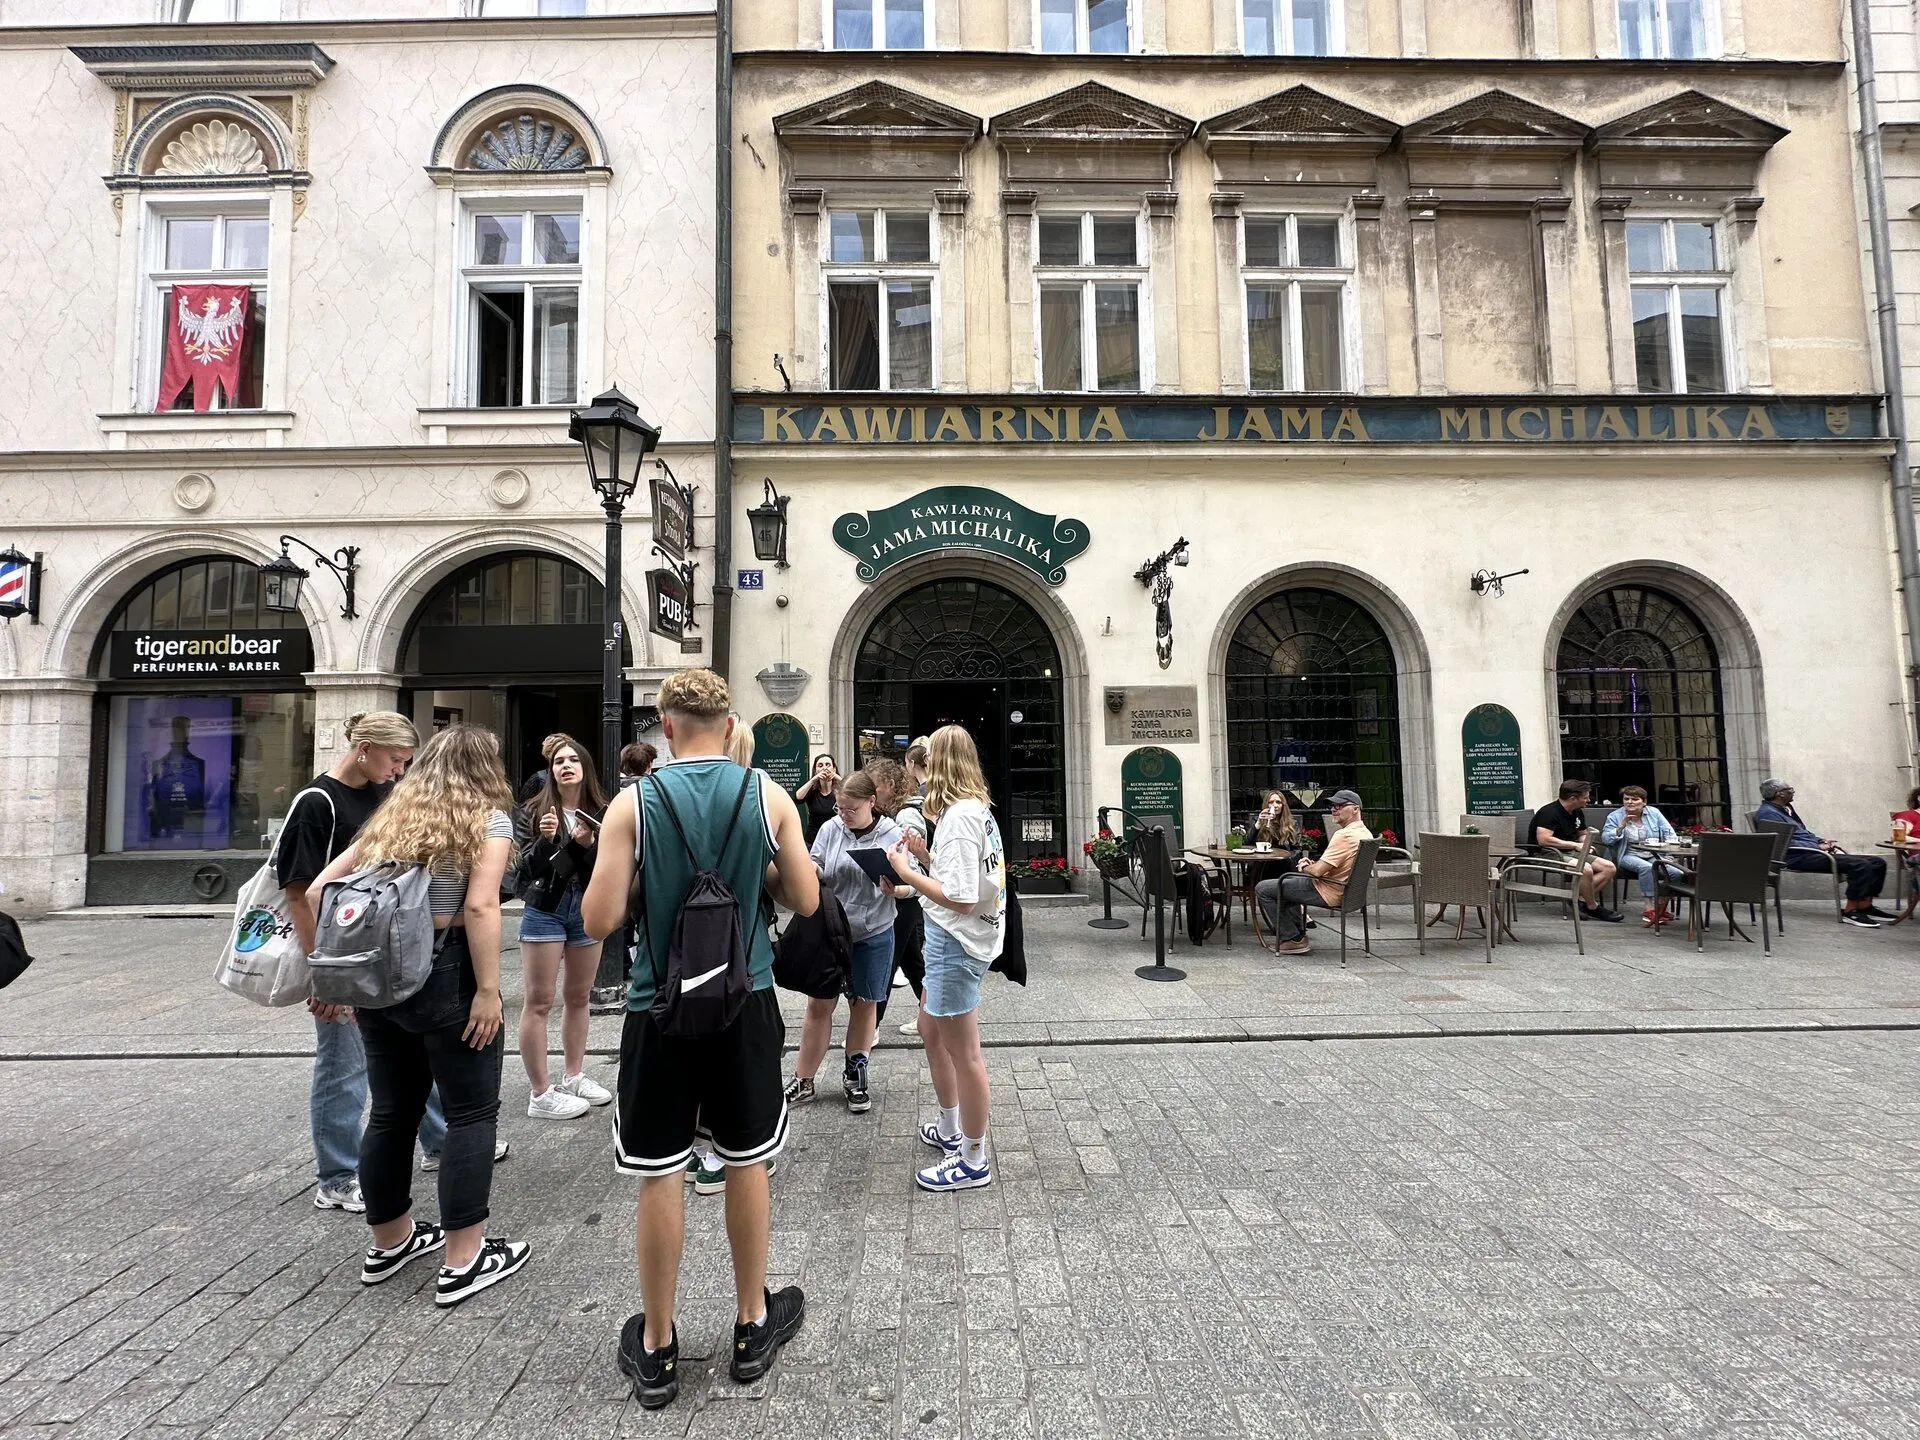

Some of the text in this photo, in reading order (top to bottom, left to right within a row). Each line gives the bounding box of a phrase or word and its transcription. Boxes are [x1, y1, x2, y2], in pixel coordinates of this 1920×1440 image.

[760, 406, 1782, 441] KAWIARNIA JAMA MICHALIKA
[911, 504, 1013, 522] KAWIARNIA
[758, 529, 772, 542] 45
[870, 520, 1051, 565] JAMA MICHALIKA
[742, 574, 760, 586] 45
[659, 592, 681, 623] PUB
[135, 634, 282, 661] tigerandbear
[133, 663, 218, 672] PERFUMERIA
[228, 662, 281, 671] BARBER
